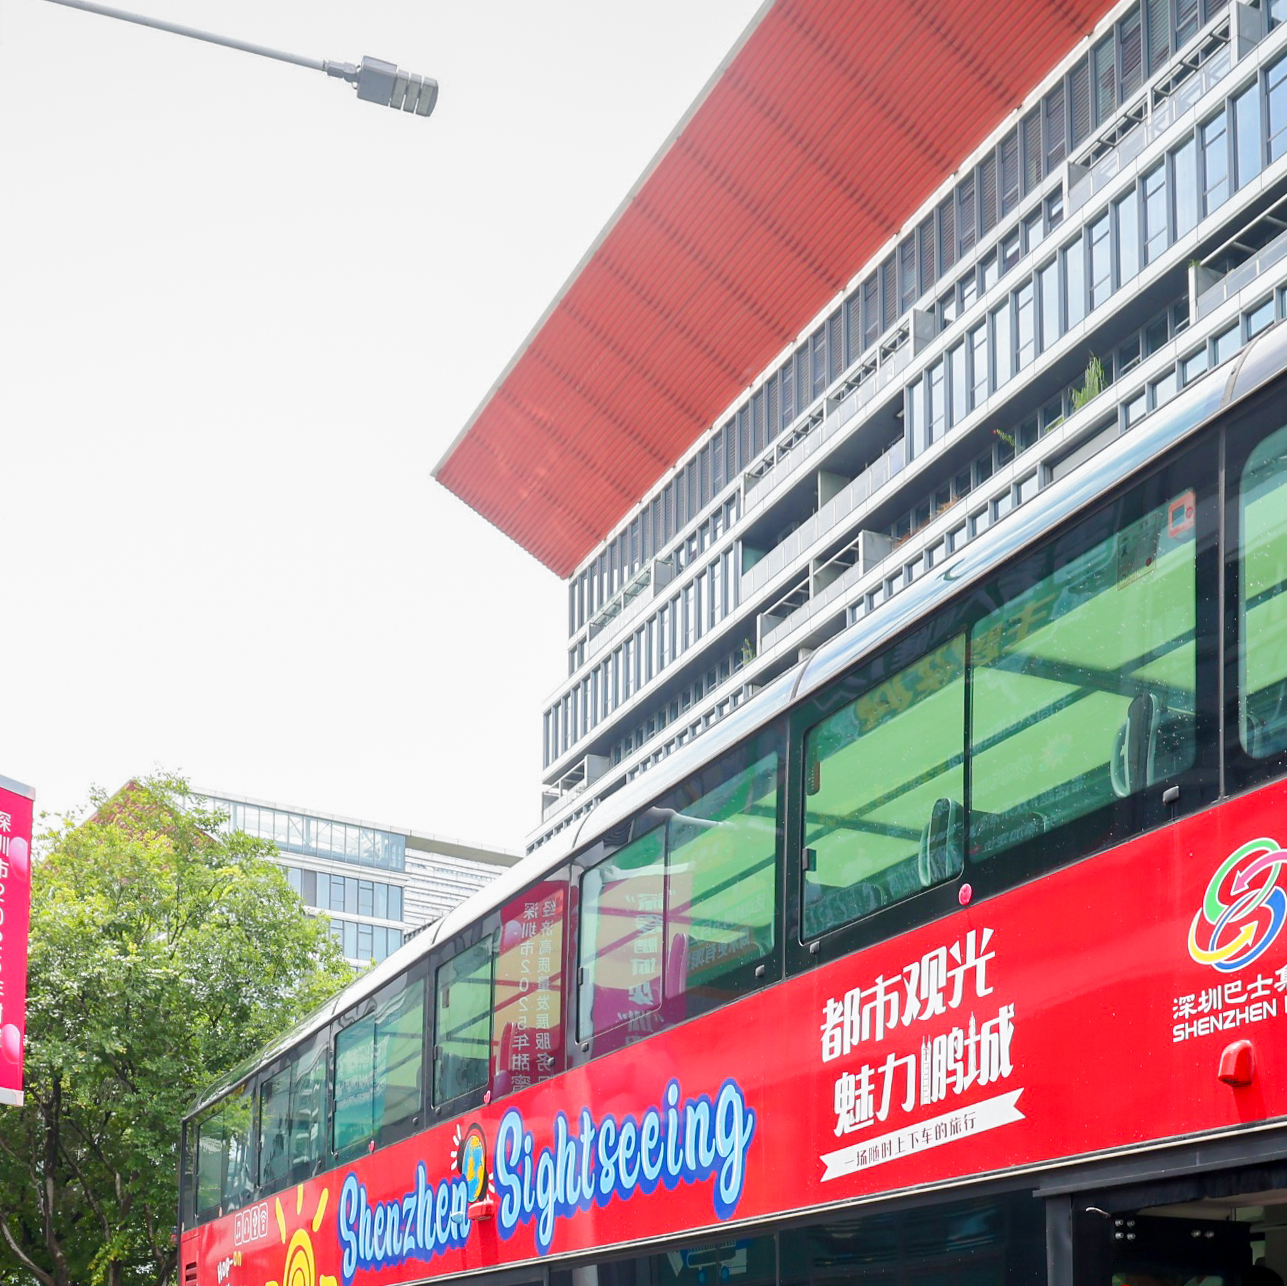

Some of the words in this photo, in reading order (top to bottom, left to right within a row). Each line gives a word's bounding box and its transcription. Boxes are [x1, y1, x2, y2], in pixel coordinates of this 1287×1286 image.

[820, 927, 997, 1064] 都市观光
[1172, 997, 1277, 1042] SHENZHEN
[833, 1003, 1015, 1138] 魅力鹏城
[340, 1173, 471, 1286] Shenzhen
[496, 1080, 754, 1252] Sightseeing
[844, 1111, 977, 1167] 一场随时上下车的旅行
